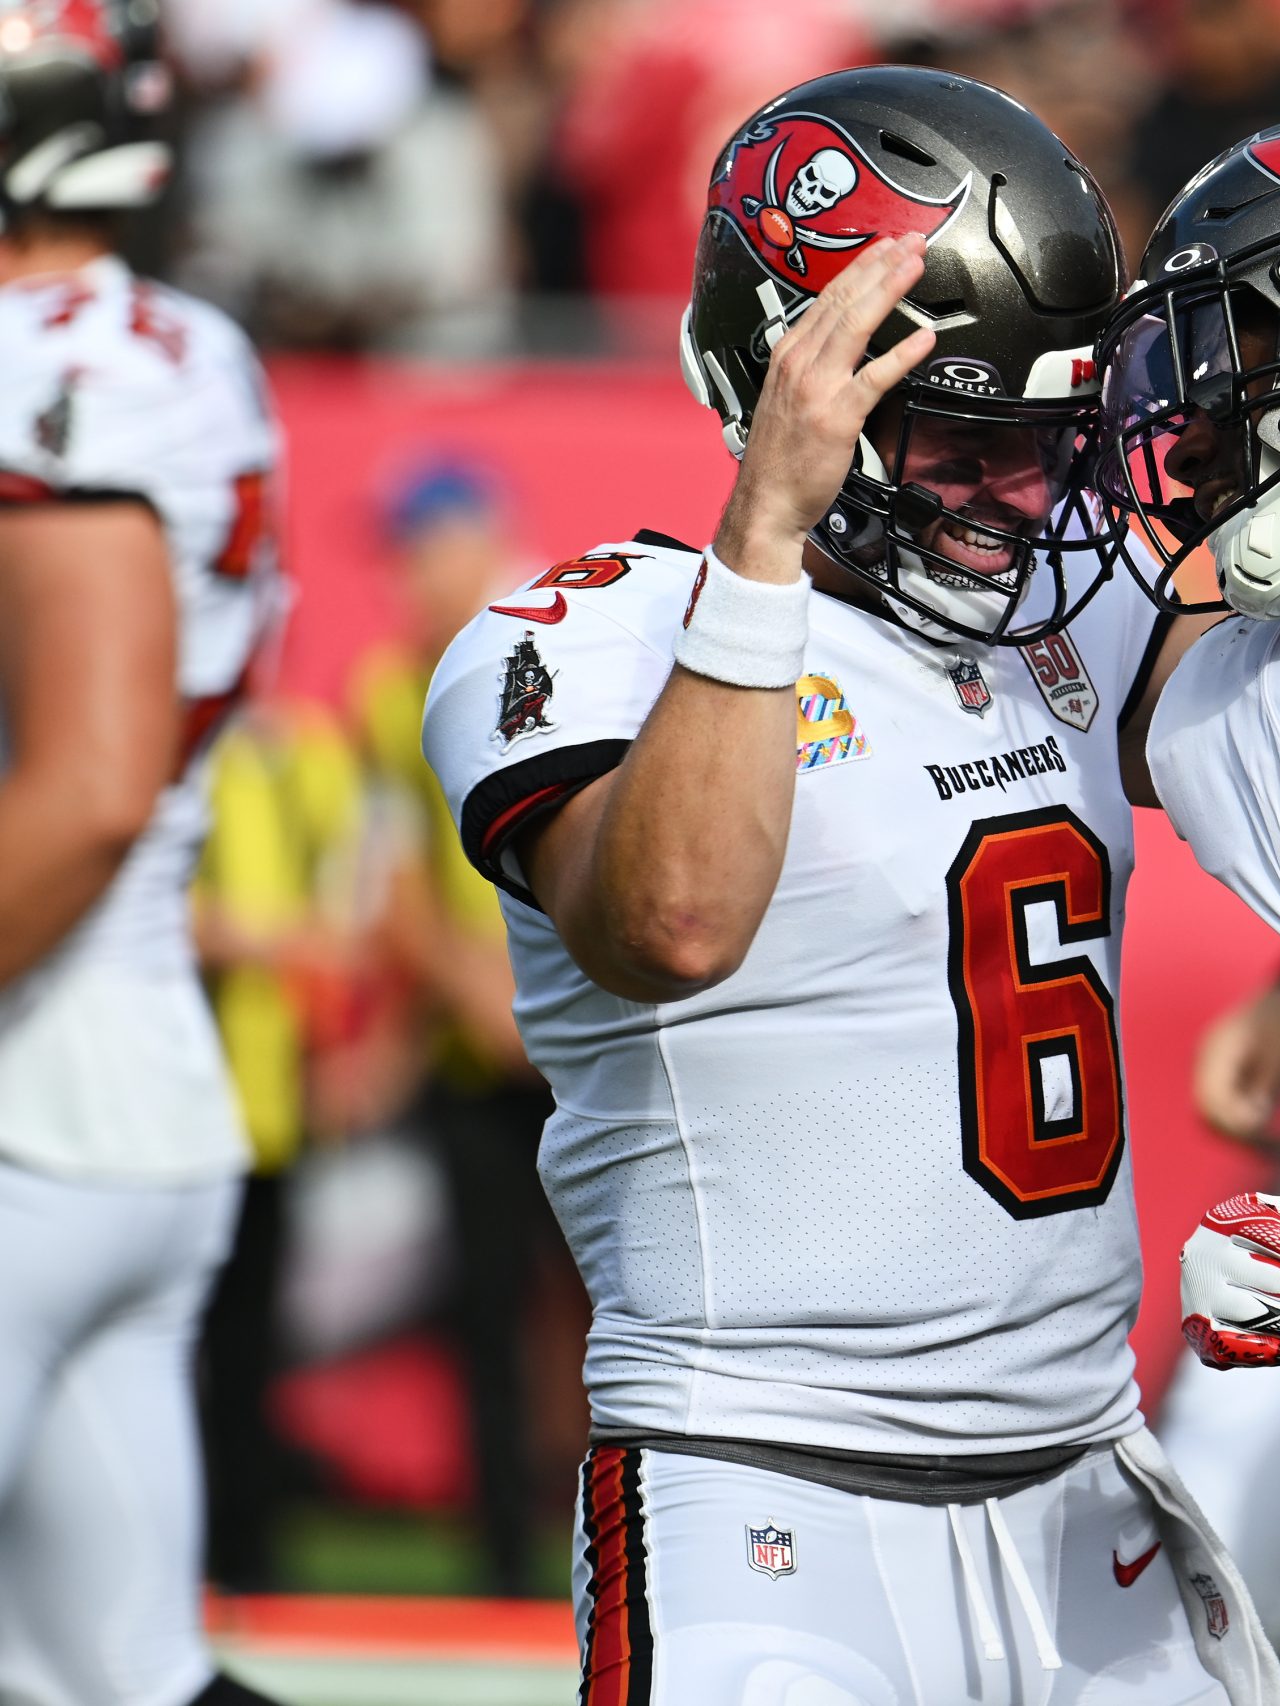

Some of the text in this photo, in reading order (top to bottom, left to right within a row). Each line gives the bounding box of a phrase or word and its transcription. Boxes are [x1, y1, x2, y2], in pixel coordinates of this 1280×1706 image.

[930, 374, 1000, 395] OAKLEY
[1023, 633, 1080, 688] 50
[959, 680, 988, 706] NFL
[923, 735, 1067, 801] BUCCANEERS
[946, 804, 1125, 1221] 6
[756, 1545, 790, 1568] NFL
